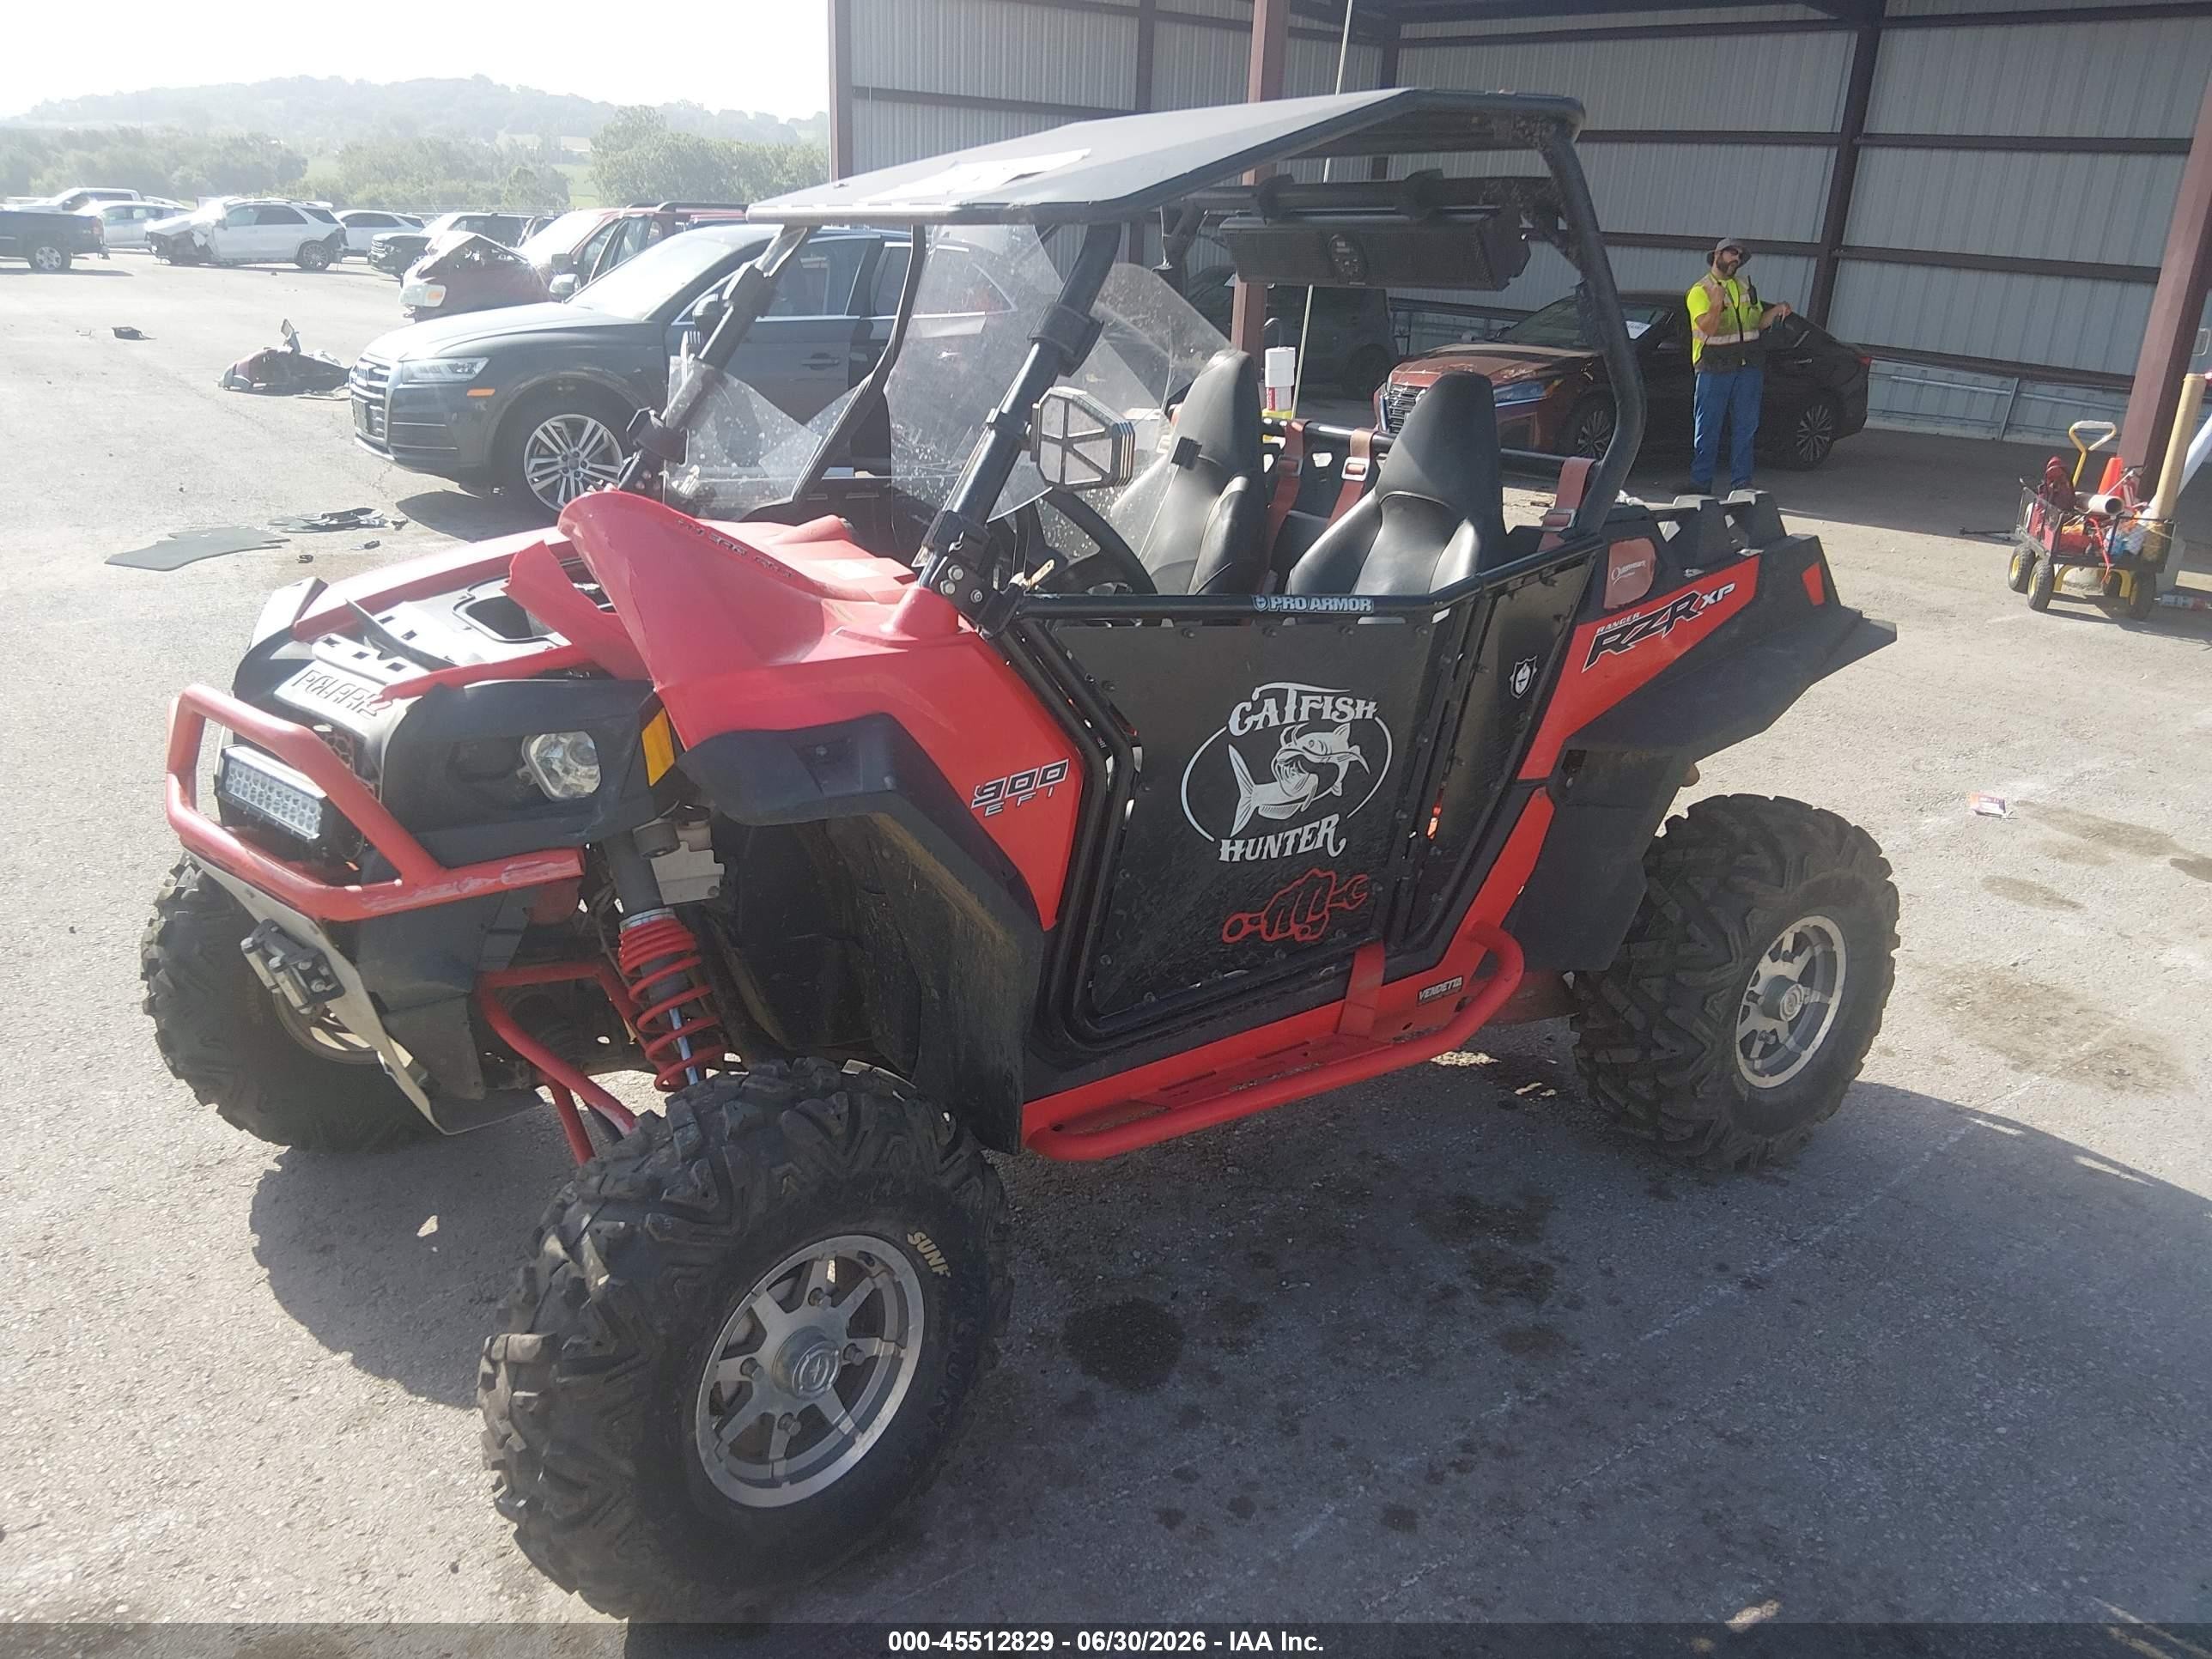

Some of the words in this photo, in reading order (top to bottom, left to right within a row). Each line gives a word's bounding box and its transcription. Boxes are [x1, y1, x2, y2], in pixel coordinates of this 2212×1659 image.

[1269, 596, 1308, 611] PRO
[1309, 597, 1373, 612] ARMOR
[1581, 590, 1704, 673] RZR
[1699, 582, 1735, 609] XP
[1596, 612, 1642, 635] RANGER
[1228, 682, 1378, 737] CATFISH
[970, 758, 1069, 809] 900
[1218, 813, 1346, 862] HUNTER
